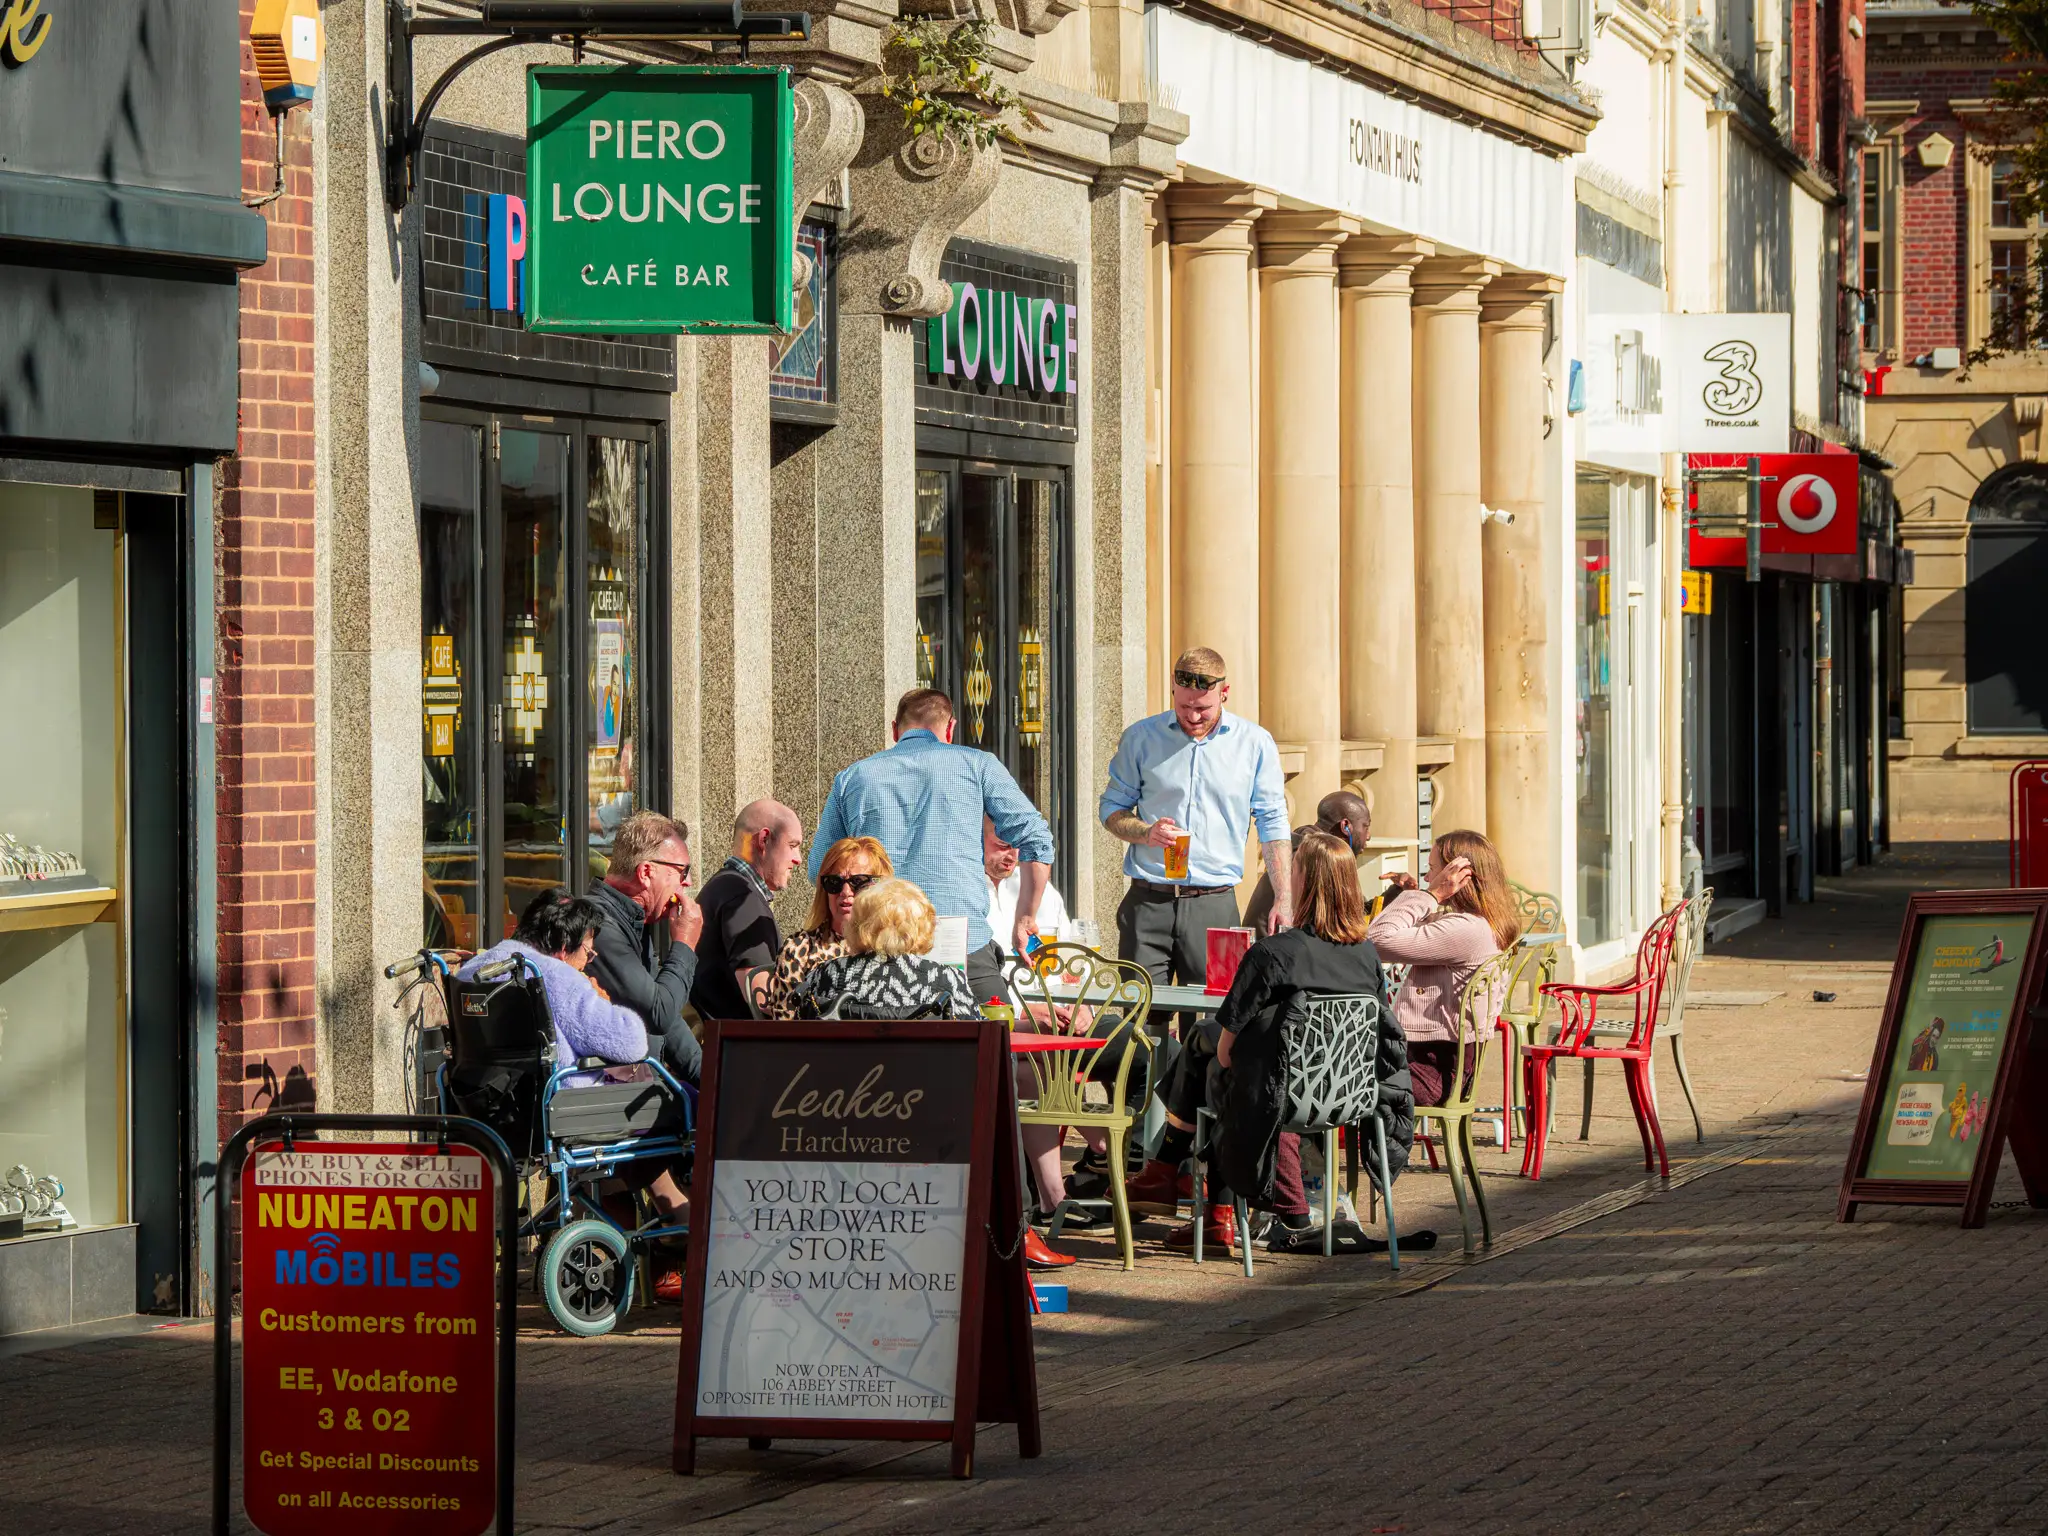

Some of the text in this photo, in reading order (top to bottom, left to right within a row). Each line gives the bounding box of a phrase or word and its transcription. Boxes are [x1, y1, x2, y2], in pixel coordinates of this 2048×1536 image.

[589, 119, 726, 160] PIERO
[552, 182, 761, 224] LOUNGE
[580, 258, 730, 286] CAFÉ BAR
[934, 282, 1078, 394] LOUNGE
[1703, 339, 1763, 416] 3
[1705, 418, 1760, 428] Three.co.uk
[433, 640, 451, 669] CAFÉ
[436, 723, 449, 746] BAR
[771, 1062, 925, 1121] Leakes
[780, 1126, 911, 1155] Hardware
[277, 1154, 461, 1172] WE BUY & SELL
[258, 1169, 479, 1189] PHONES FOR CASH
[745, 1178, 941, 1206] YOUR LOCAL
[258, 1193, 477, 1232] NUNEATON
[753, 1207, 927, 1234] HARDWARE
[787, 1236, 888, 1263] STORE
[275, 1249, 461, 1289] MOBILES
[713, 1270, 957, 1292] AND SO MUCH MORE
[259, 1308, 477, 1335] Customers from
[279, 1367, 458, 1395] EE, Vodafone
[775, 1363, 884, 1378] NOW OPEN AT
[761, 1378, 897, 1394] 106 ABBEY STREET
[701, 1391, 949, 1409] OPPOSITE THE HAMPTON HOTEL
[317, 1408, 410, 1432] 3 & O2
[259, 1450, 479, 1472] Get Special Discounts
[278, 1491, 461, 1511] on all Accessories
